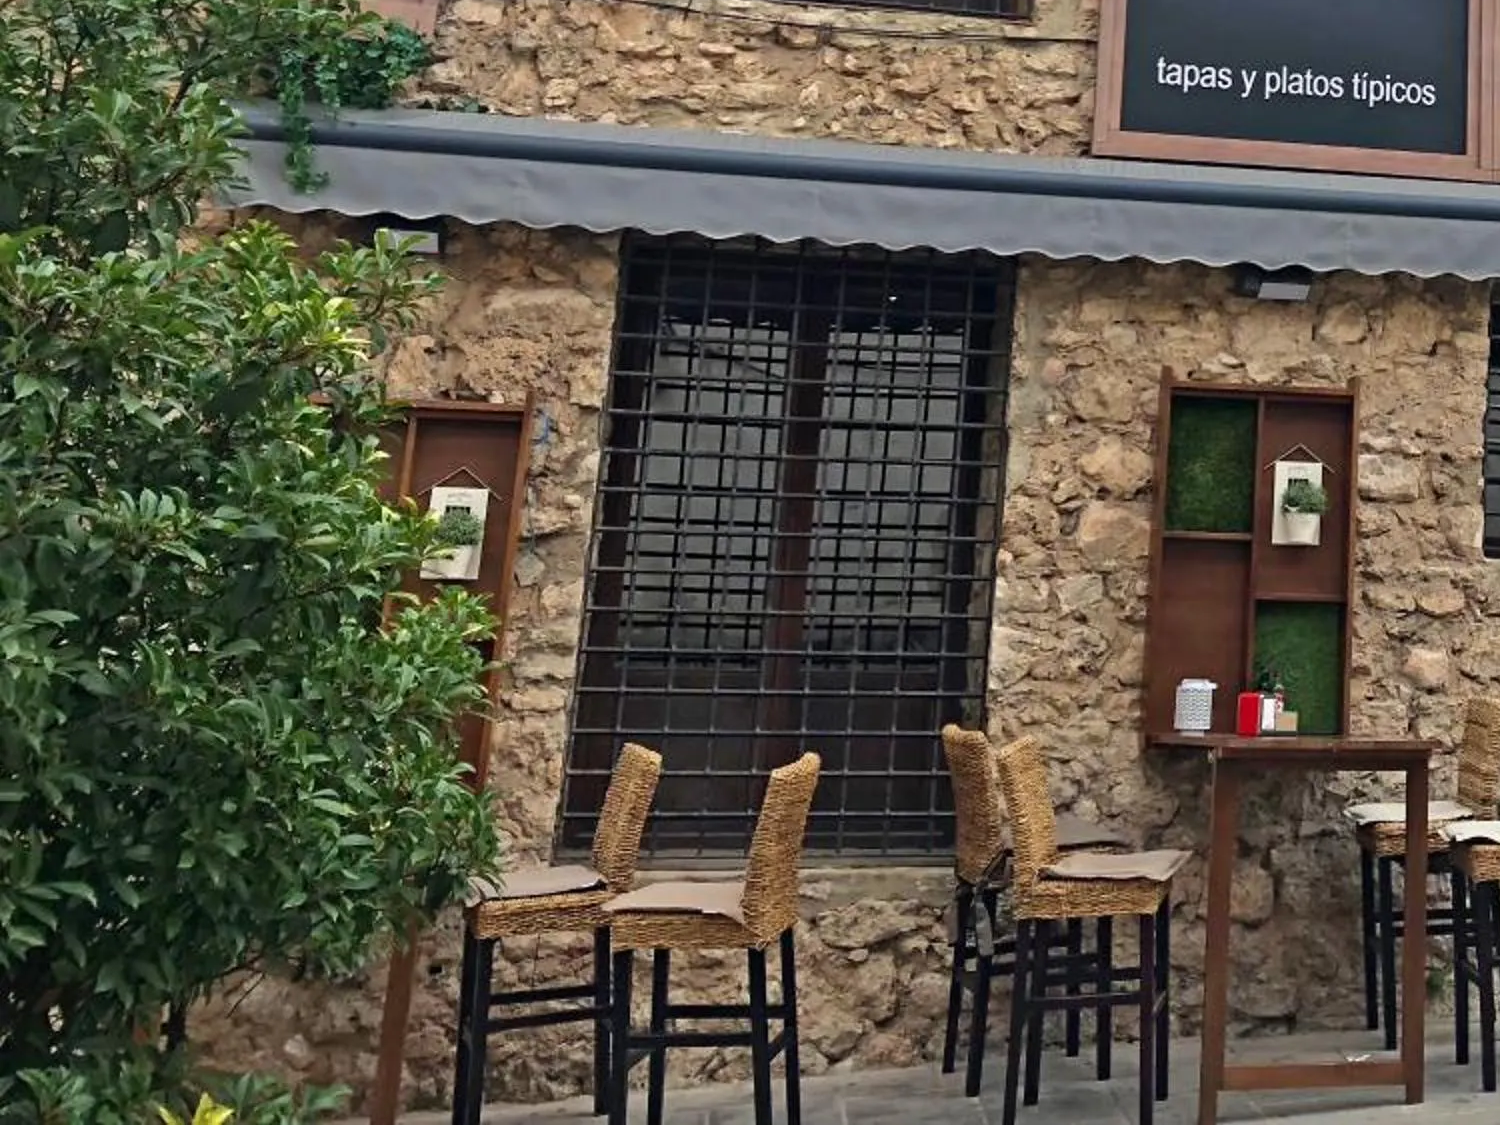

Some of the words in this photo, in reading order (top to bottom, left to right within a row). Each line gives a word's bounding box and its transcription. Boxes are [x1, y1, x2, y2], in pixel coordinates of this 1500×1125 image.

[1156, 56, 1233, 93] tapas
[1240, 69, 1257, 98] y
[1264, 65, 1345, 100] platos
[1351, 72, 1437, 108] típicos
